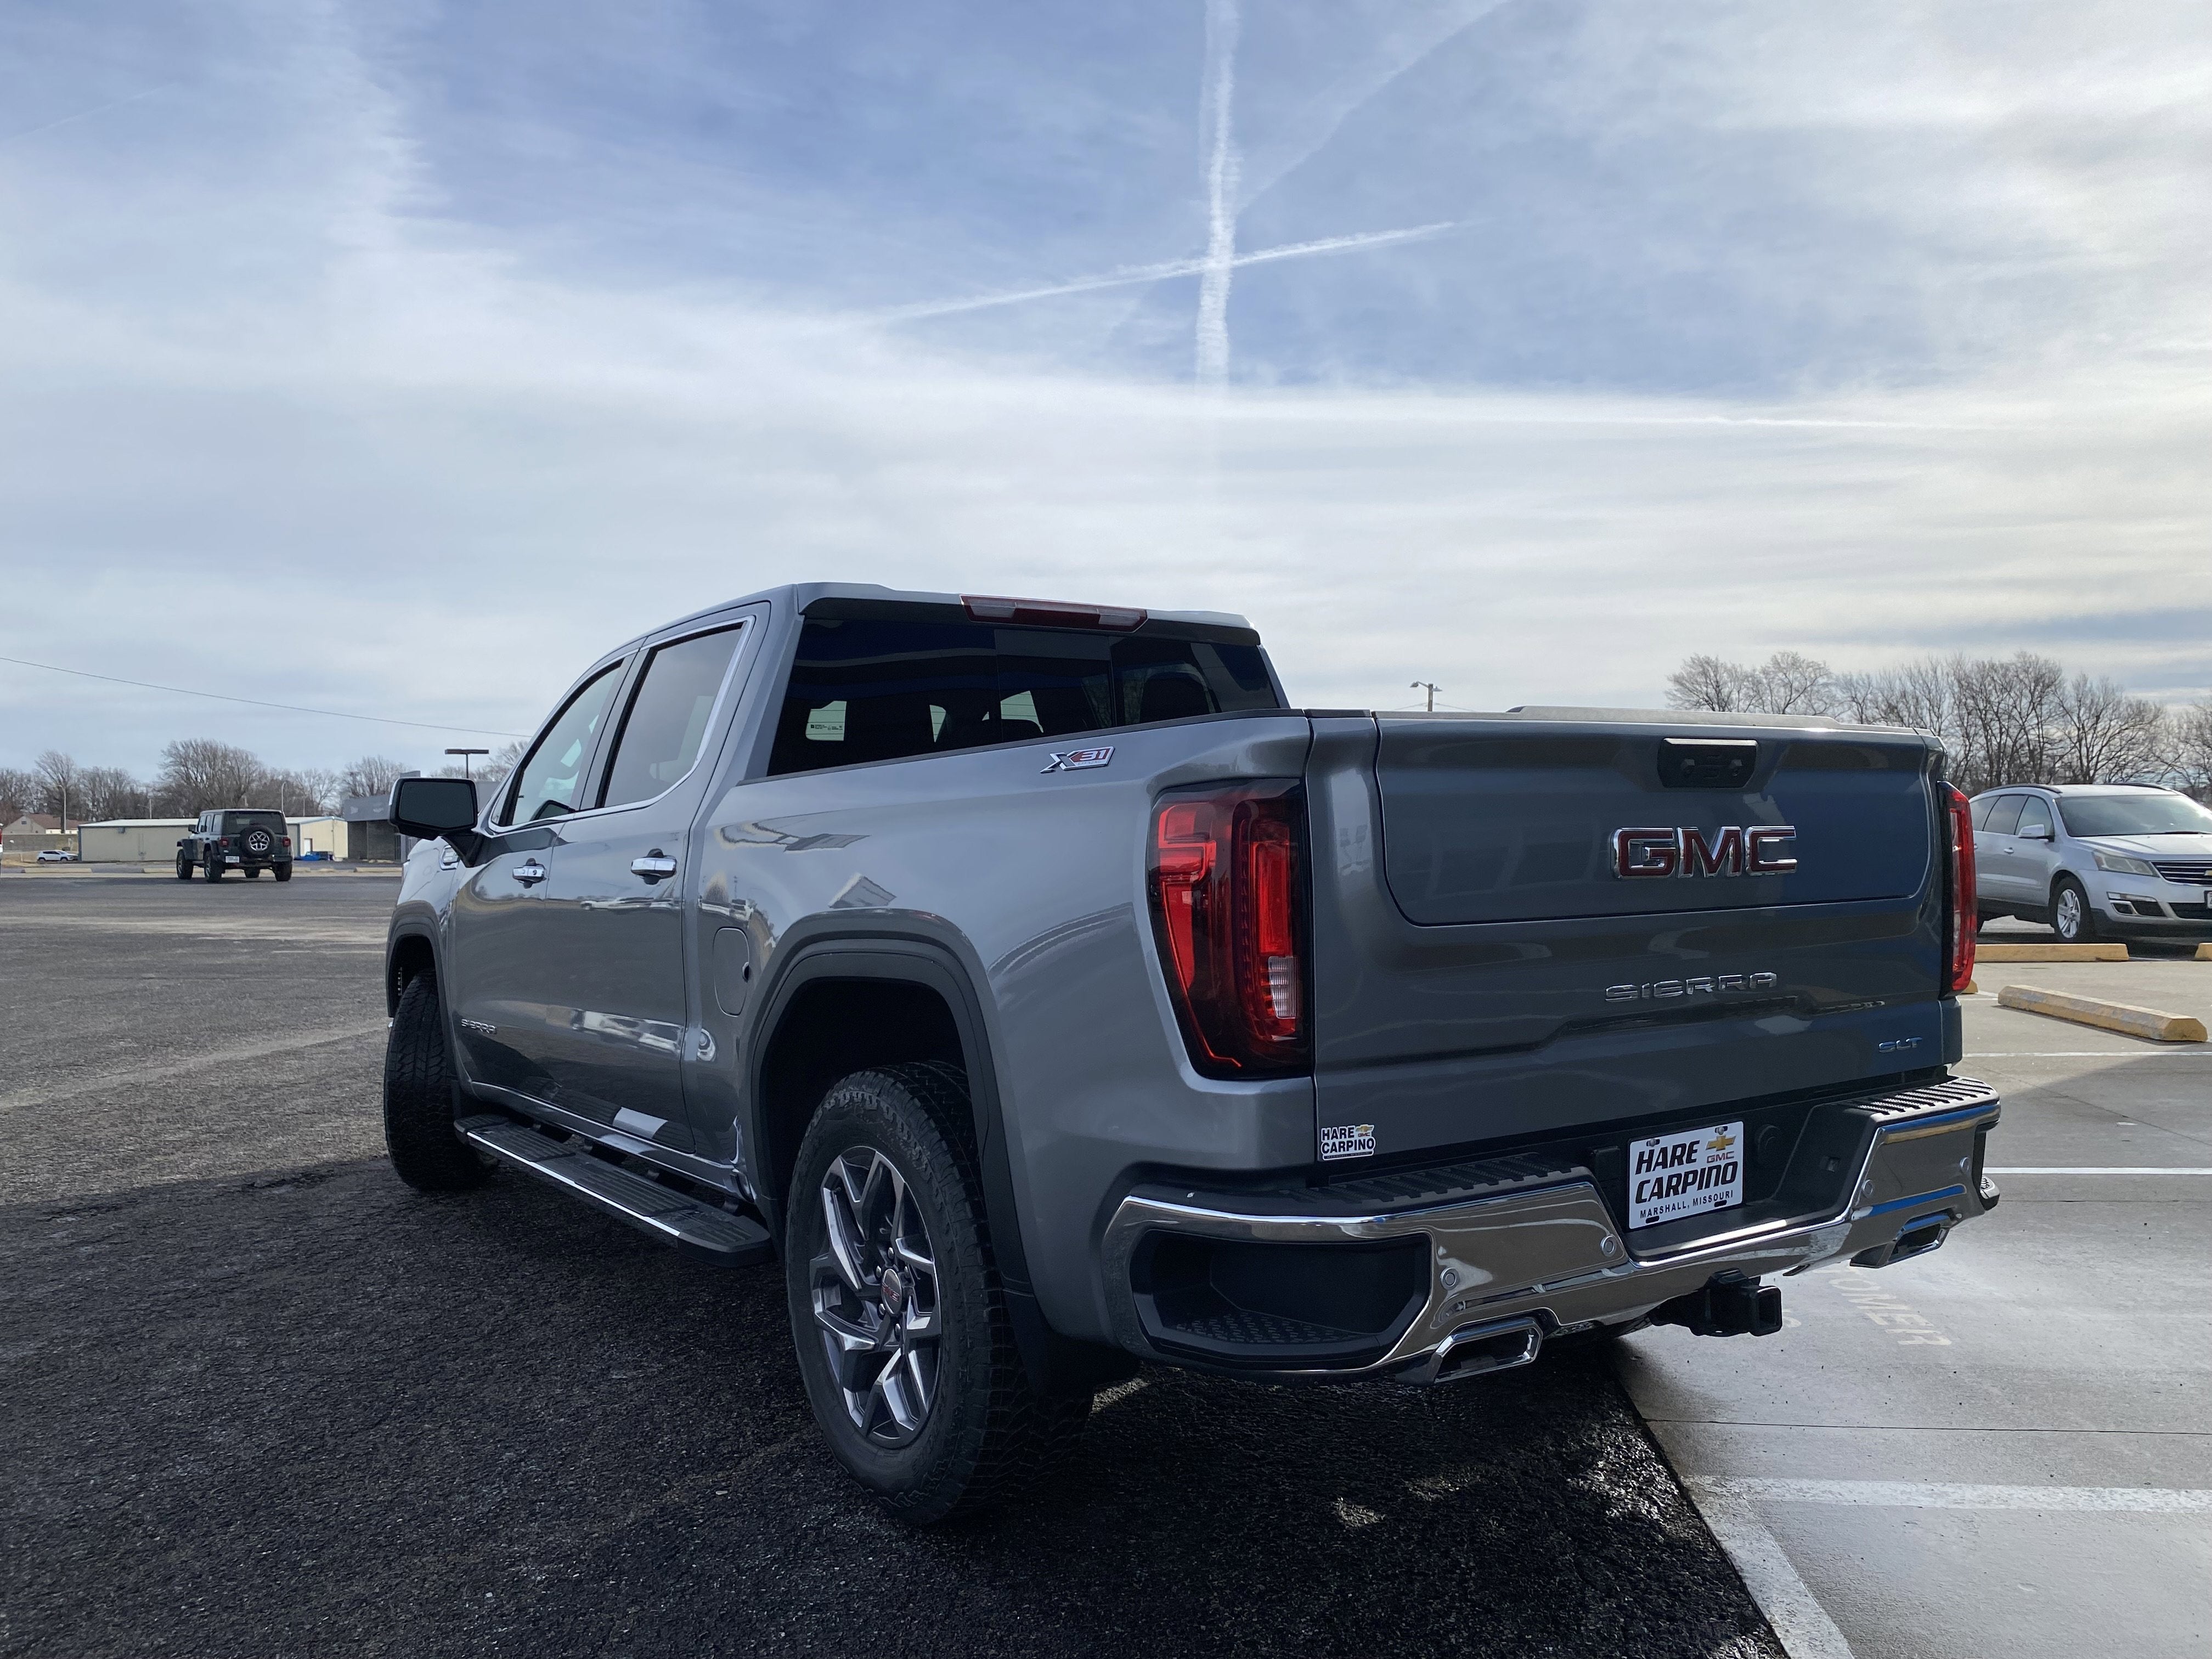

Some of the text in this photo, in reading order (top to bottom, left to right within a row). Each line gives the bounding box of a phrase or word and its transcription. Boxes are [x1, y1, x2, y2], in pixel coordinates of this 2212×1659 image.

[1612, 826, 1797, 878] GMC
[1605, 972, 1777, 1003] SIERRA
[1878, 1037, 1923, 1053] SLT
[1322, 1127, 1355, 1141] HARE
[1322, 1138, 1375, 1154] CARPINO
[1635, 1140, 1700, 1175] HARE
[1707, 1151, 1735, 1164] GMC
[1635, 1161, 1738, 1204] CARPINO
[1640, 1190, 1733, 1218] MARSHALL, MISSOURI
